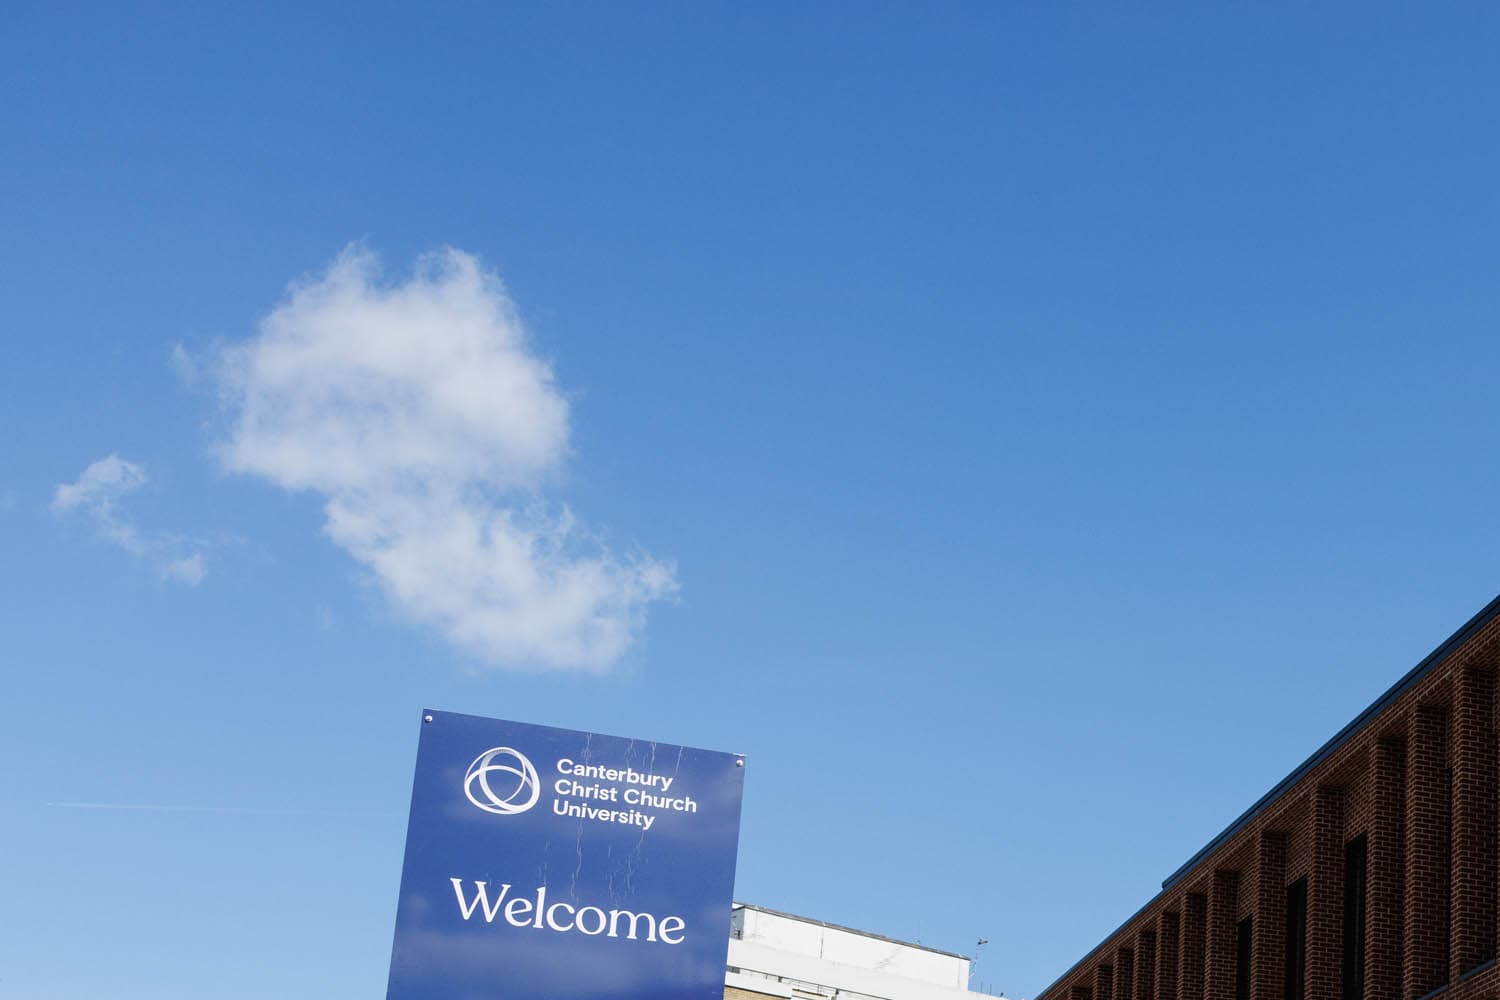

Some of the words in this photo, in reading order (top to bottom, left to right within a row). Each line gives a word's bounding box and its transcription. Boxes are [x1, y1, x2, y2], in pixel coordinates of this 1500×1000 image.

[557, 758, 674, 792] Canterbury
[554, 779, 618, 802] Christ
[623, 788, 697, 813] Church
[553, 799, 656, 831] University
[450, 877, 686, 945] Welcome
